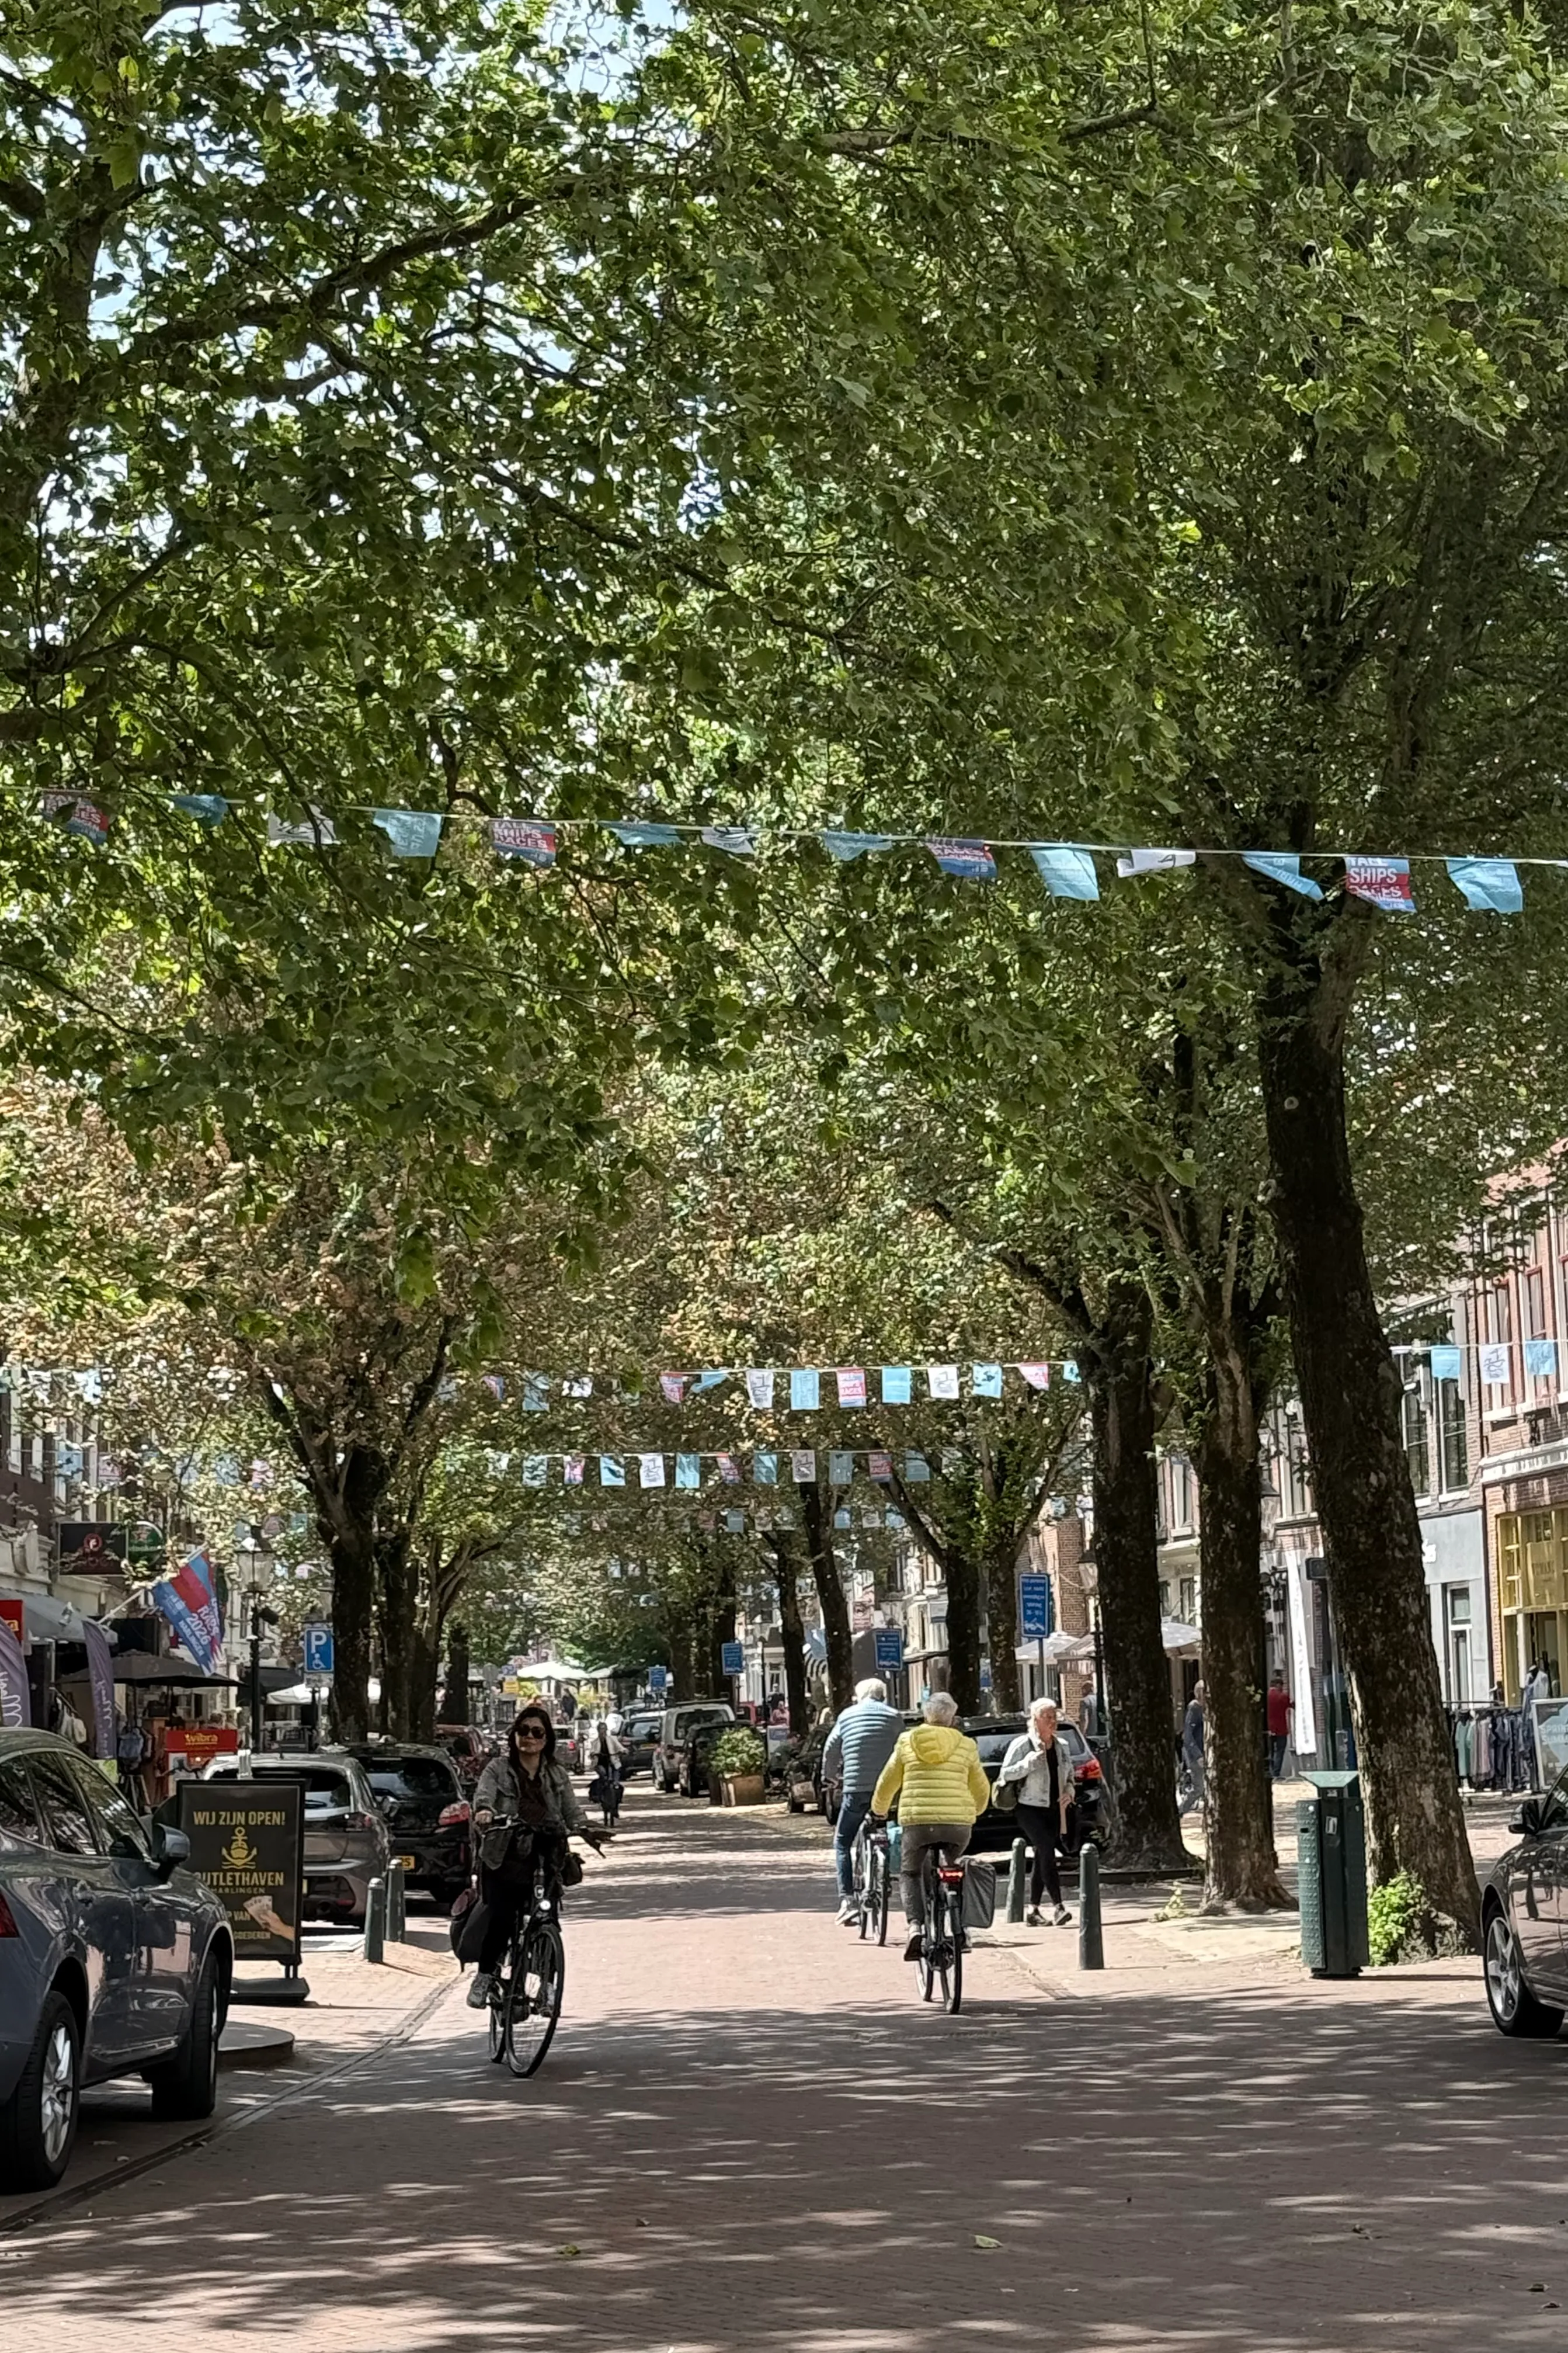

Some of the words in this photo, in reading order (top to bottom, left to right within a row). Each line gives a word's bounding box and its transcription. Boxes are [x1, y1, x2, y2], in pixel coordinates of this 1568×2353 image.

[1350, 868, 1397, 883] SHIPS
[186, 1613, 212, 1645] 2026
[311, 1631, 327, 1654] P
[193, 1811, 215, 1826] WIJ
[219, 1811, 245, 1826] ZIJN
[248, 1811, 286, 1826] OPEN!
[234, 1911, 251, 1921] VAN
